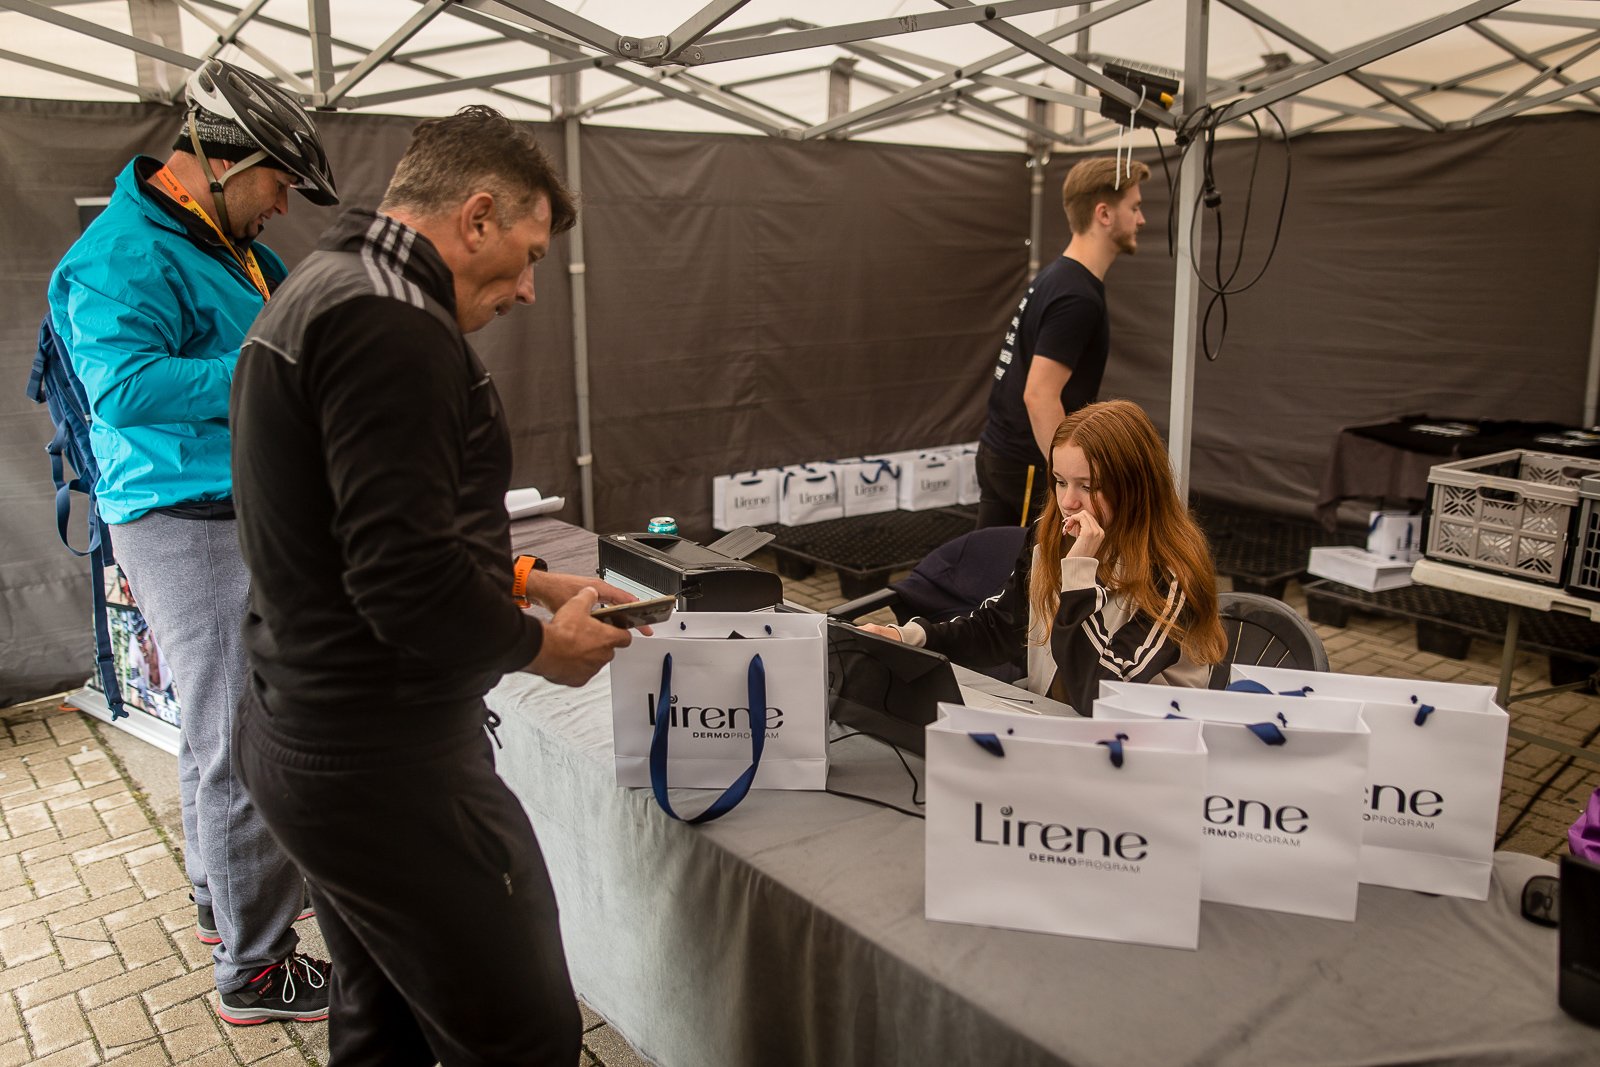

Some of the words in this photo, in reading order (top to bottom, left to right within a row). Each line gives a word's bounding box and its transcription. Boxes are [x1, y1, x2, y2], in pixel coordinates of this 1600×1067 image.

[692, 731, 779, 739] DERMOPROAM
[1203, 795, 1309, 834] ene
[1362, 813, 1435, 831] OPROGRAM
[974, 801, 1148, 862] Lirene
[1202, 827, 1301, 847] RMOPROGRAM
[1029, 852, 1141, 874] DERMOPROGRAM
